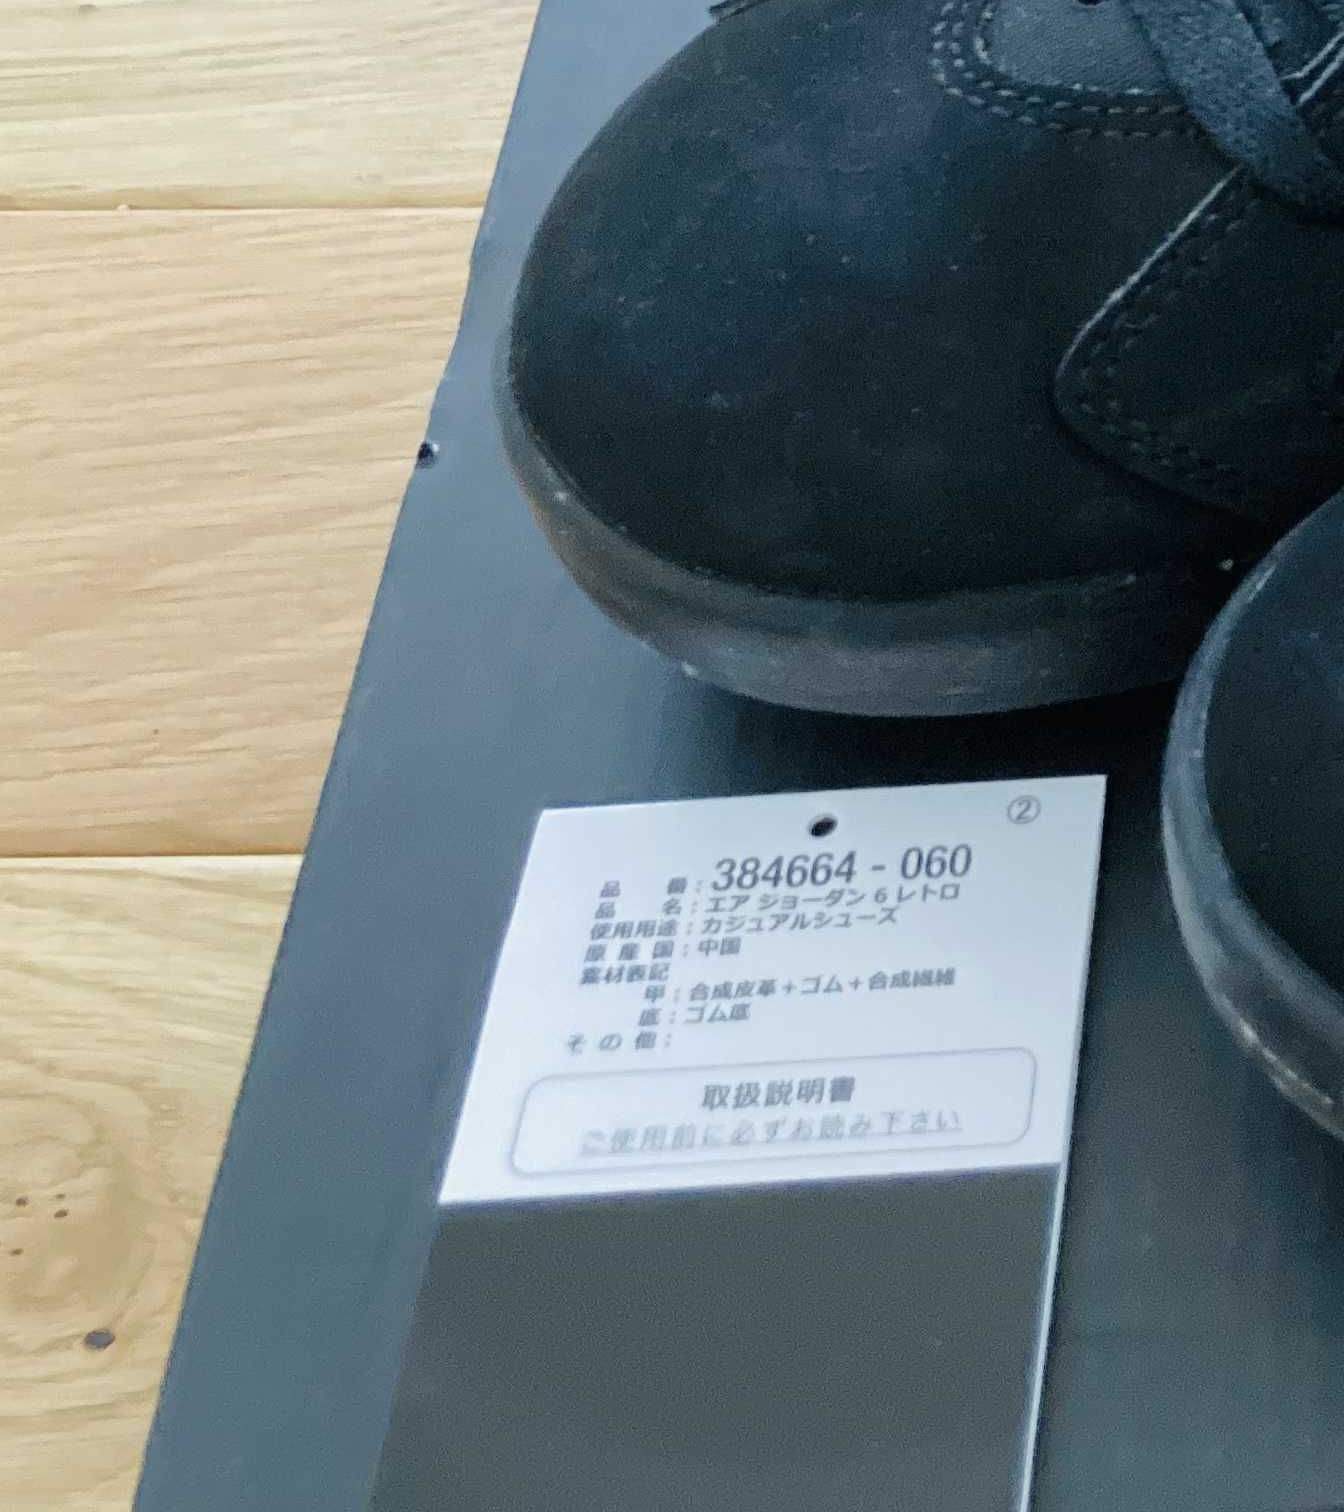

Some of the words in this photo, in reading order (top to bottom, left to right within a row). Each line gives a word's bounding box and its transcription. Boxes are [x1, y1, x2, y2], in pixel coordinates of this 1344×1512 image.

[712, 850, 856, 891] 384664
[901, 844, 972, 879] 060
[701, 906, 898, 934] カジュアルシューズ
[697, 936, 742, 956] 中国
[701, 1076, 856, 1111] 取扱説明書
